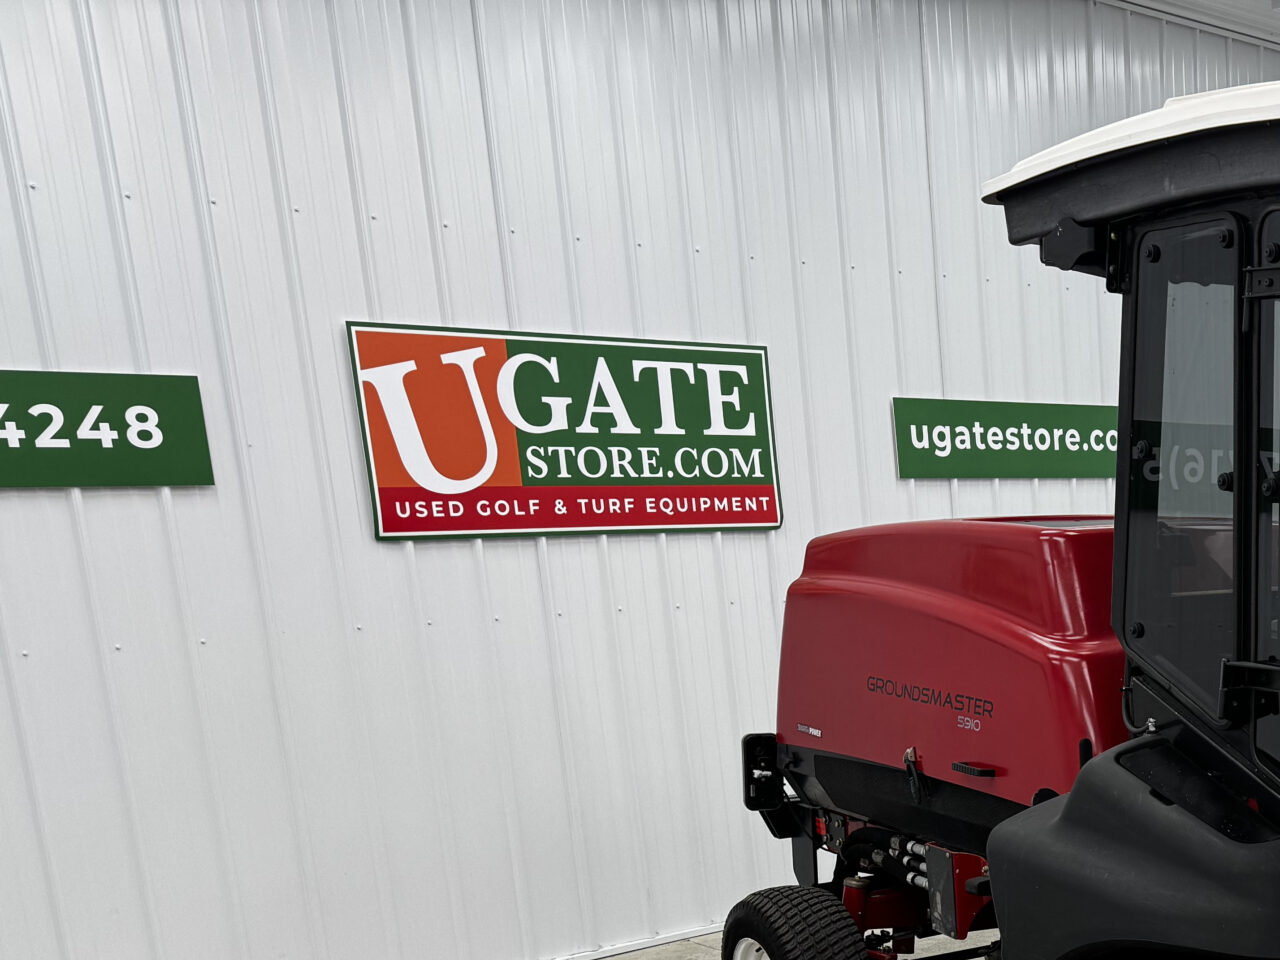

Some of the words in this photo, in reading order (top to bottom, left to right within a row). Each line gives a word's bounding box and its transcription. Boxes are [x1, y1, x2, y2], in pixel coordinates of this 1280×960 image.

[0, 403, 164, 449] 4248
[360, 346, 757, 495] UGATE
[525, 445, 765, 479] STORE.COM
[395, 500, 465, 518] USED
[476, 499, 540, 516] GOLF
[554, 499, 568, 515] &
[577, 498, 635, 514] TURF
[646, 496, 770, 515] EQUIPMENT
[866, 675, 995, 719] GROUNDSMASTER
[957, 715, 981, 732] 5910
